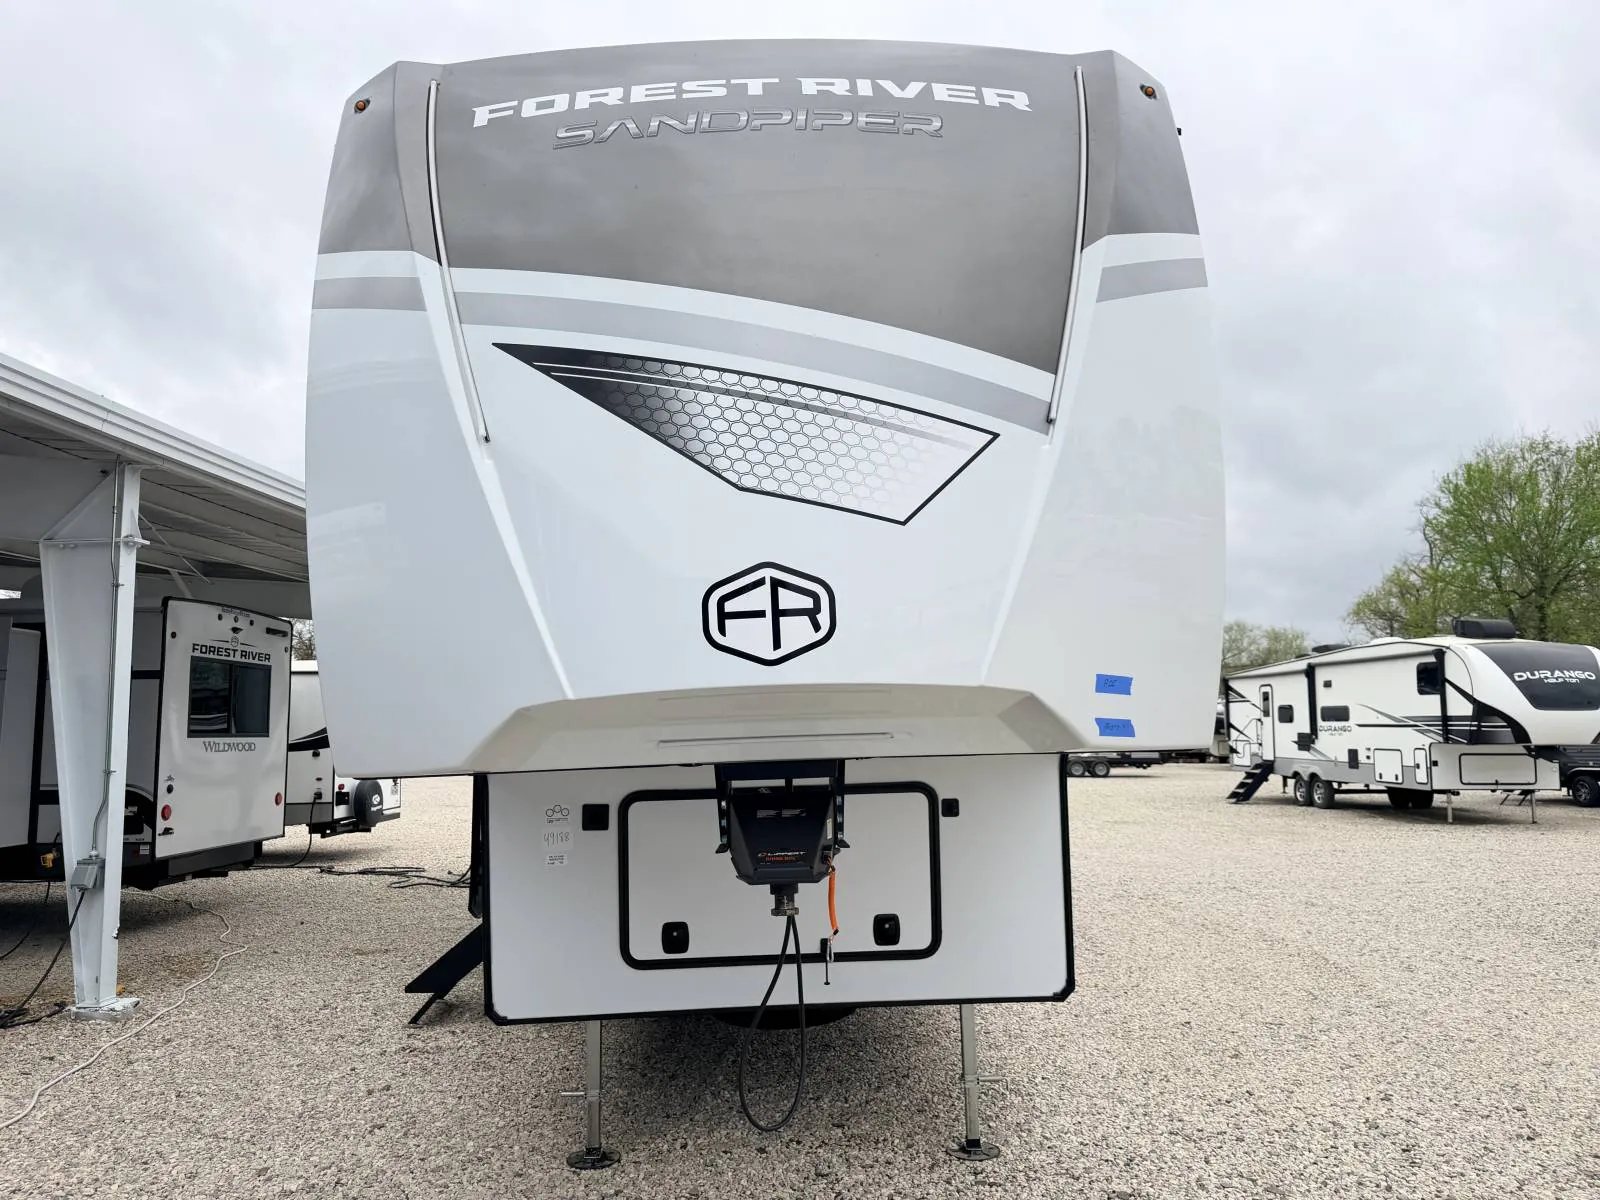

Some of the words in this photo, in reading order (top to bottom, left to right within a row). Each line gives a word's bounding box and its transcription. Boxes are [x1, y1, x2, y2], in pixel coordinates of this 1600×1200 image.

[471, 77, 780, 128] FOREST
[796, 76, 1033, 112] RIVER
[553, 107, 944, 149] SANDPIPER
[192, 643, 238, 659] FOREST
[240, 649, 271, 663] RIVER
[1513, 669, 1596, 682] DURANGO
